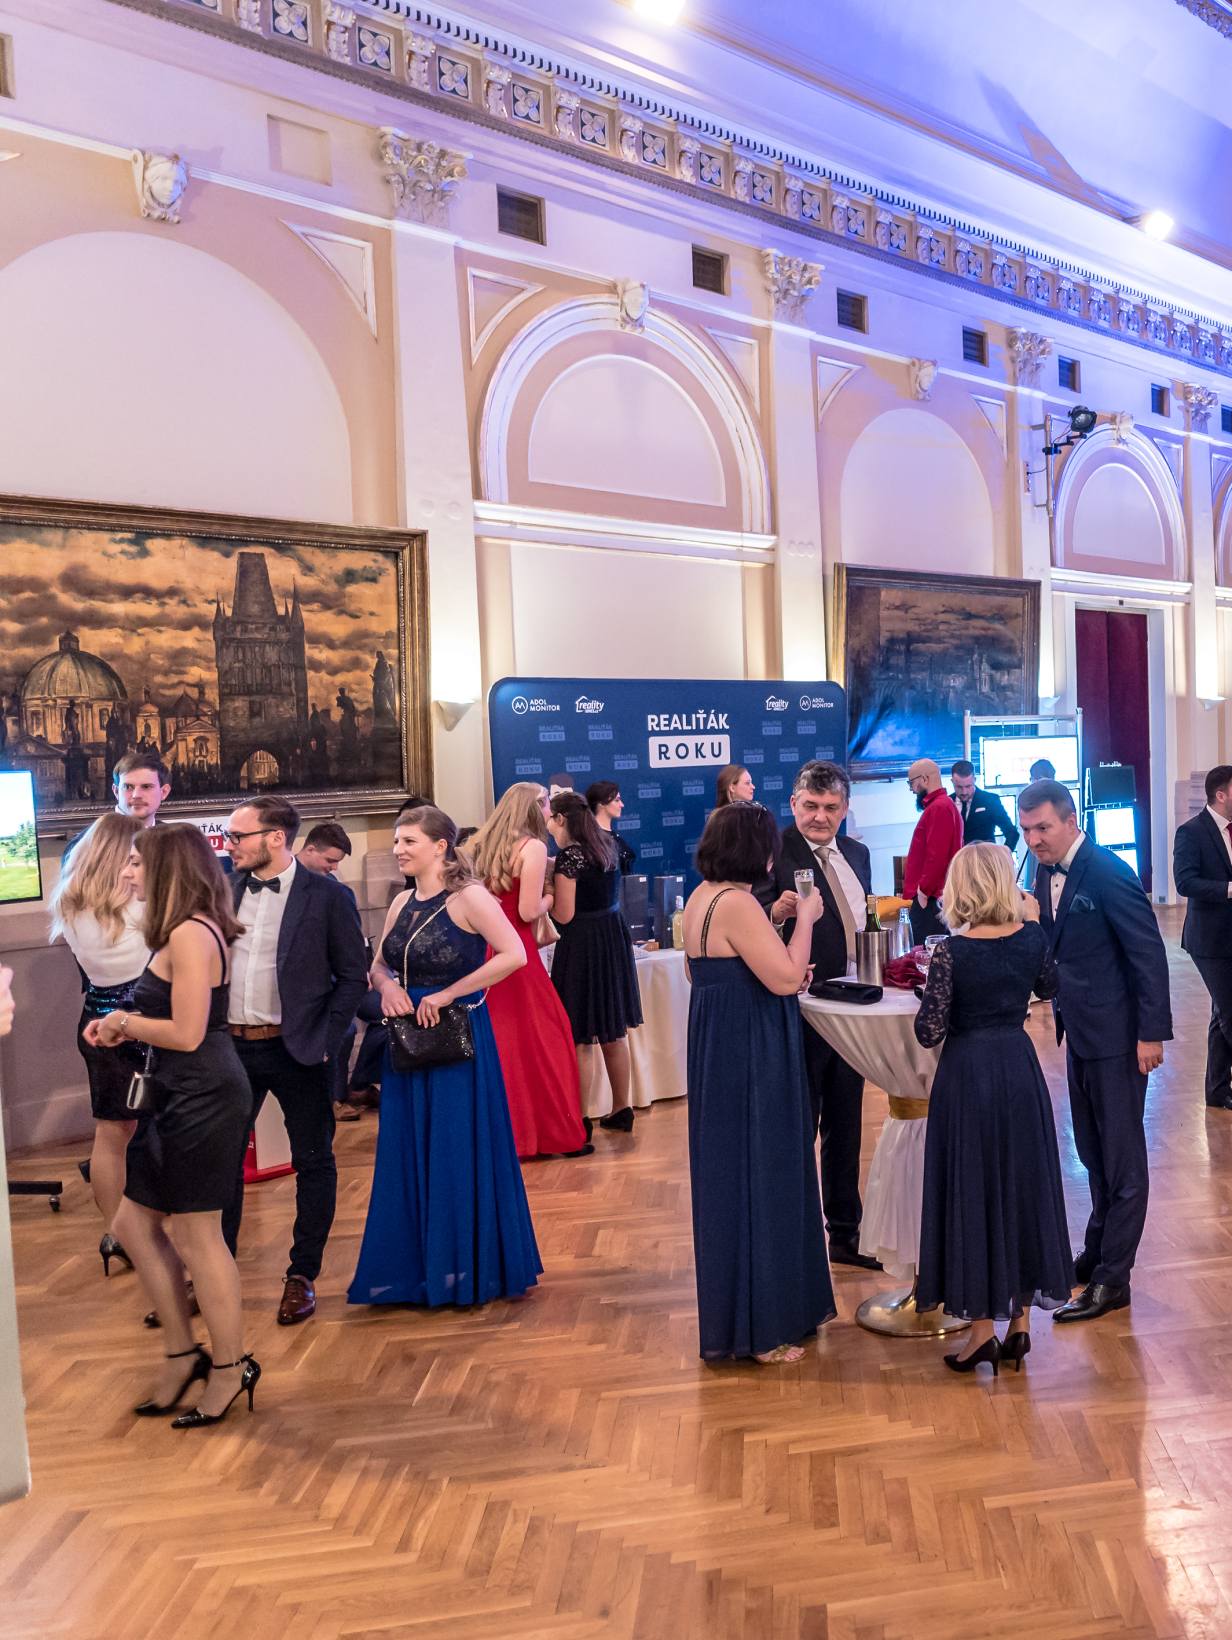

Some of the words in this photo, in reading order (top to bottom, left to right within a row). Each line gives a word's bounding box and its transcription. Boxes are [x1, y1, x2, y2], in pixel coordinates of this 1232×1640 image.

[530, 704, 561, 712] MONITOR
[579, 700, 605, 712] reality
[647, 709, 730, 731] REALIŤÁK
[658, 741, 722, 760] ROKU
